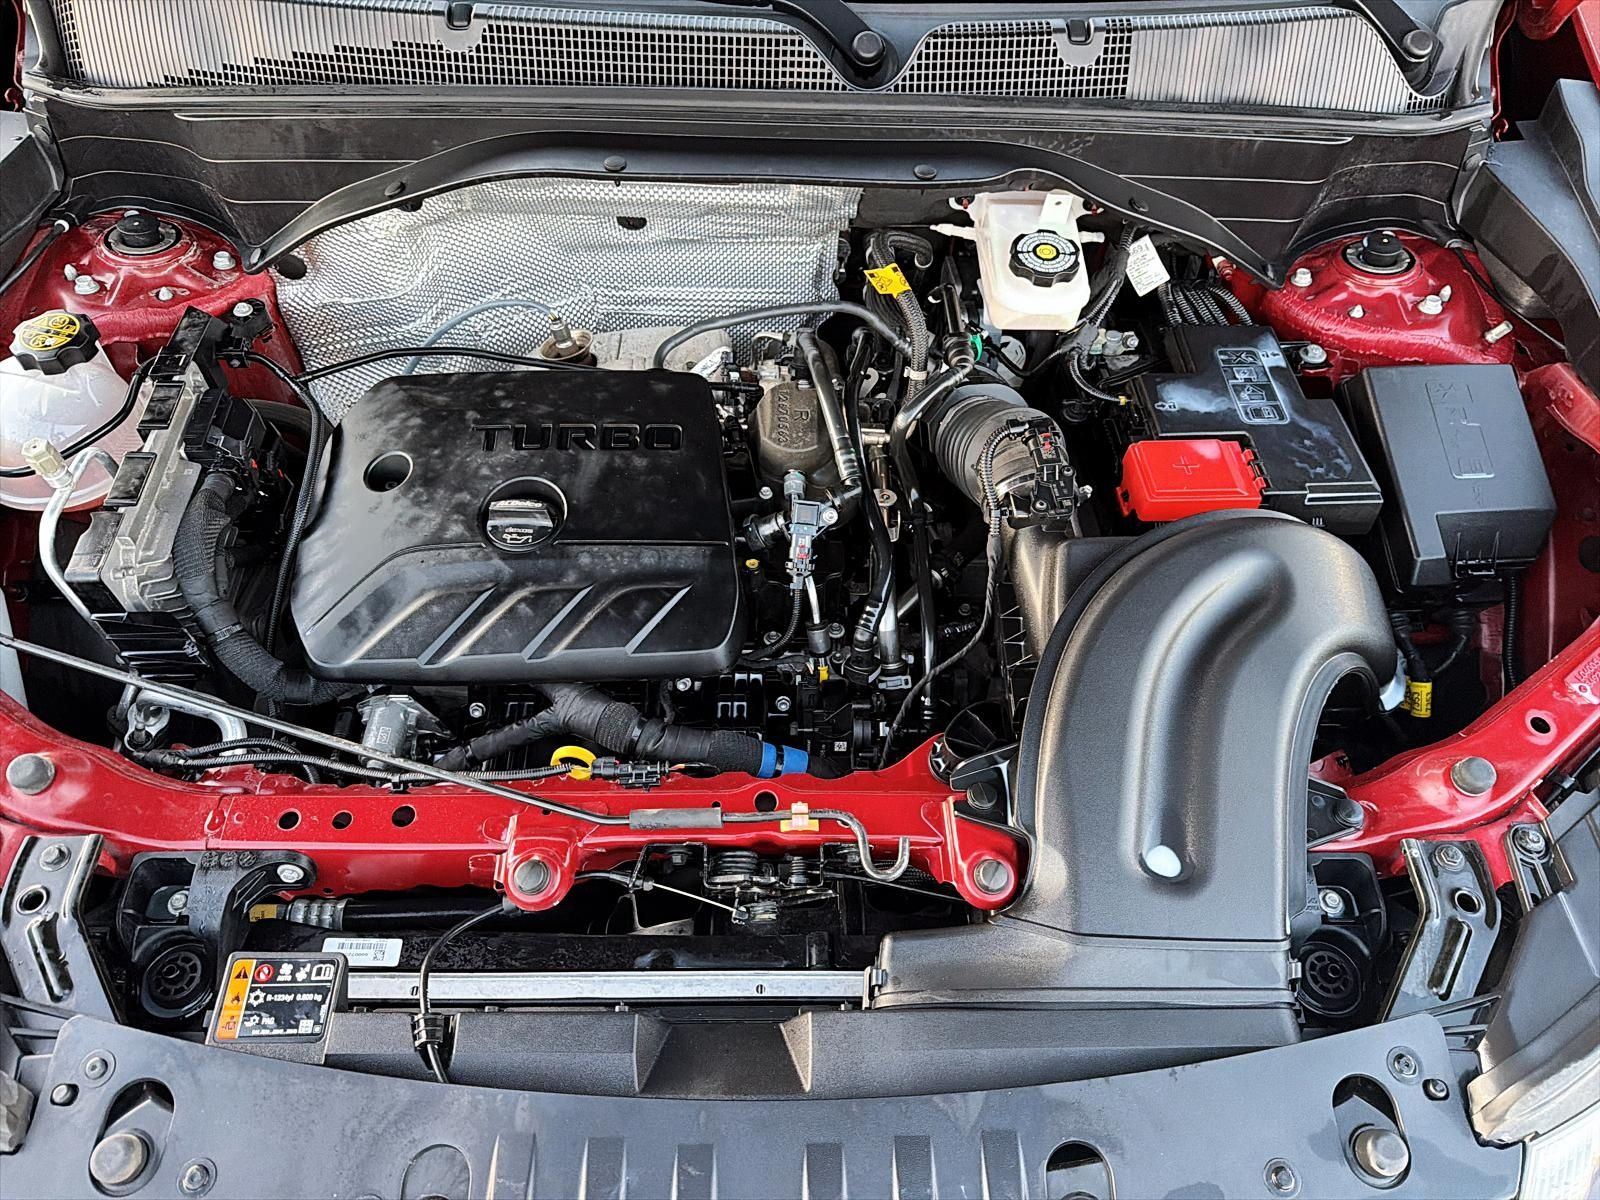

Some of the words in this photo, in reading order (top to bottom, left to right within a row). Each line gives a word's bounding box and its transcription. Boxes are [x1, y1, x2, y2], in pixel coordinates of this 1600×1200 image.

[793, 408, 811, 422] R
[472, 423, 683, 451] TURBO
[495, 500, 543, 508] ACDelco
[314, 993, 323, 1003] kg
